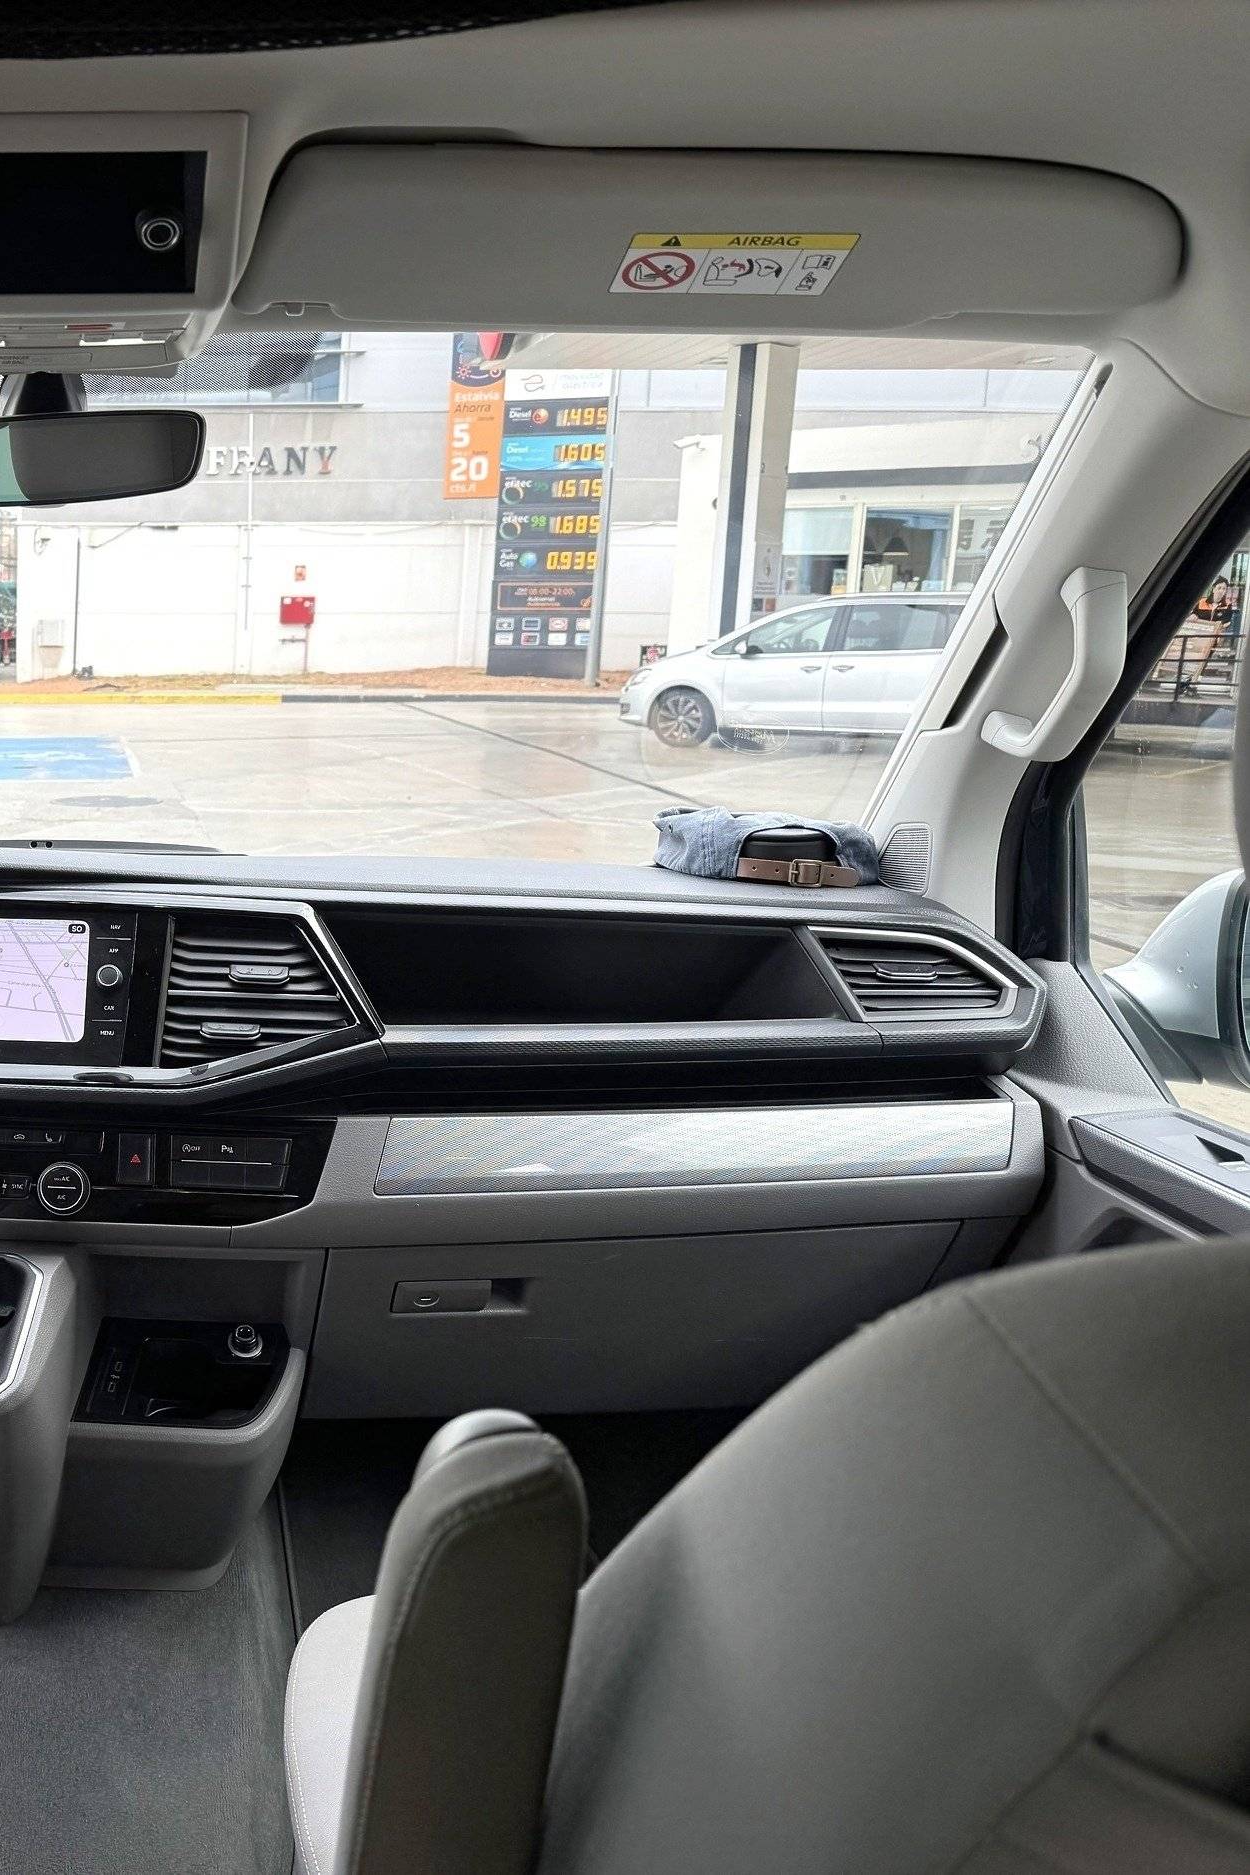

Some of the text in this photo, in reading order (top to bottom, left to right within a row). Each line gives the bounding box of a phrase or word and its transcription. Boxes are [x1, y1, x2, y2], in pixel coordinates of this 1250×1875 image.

[727, 235, 801, 247] AIRBAG
[454, 403, 492, 414] Ahorra
[452, 422, 471, 449] 5
[449, 455, 489, 482] 20
[71, 925, 83, 933] SO
